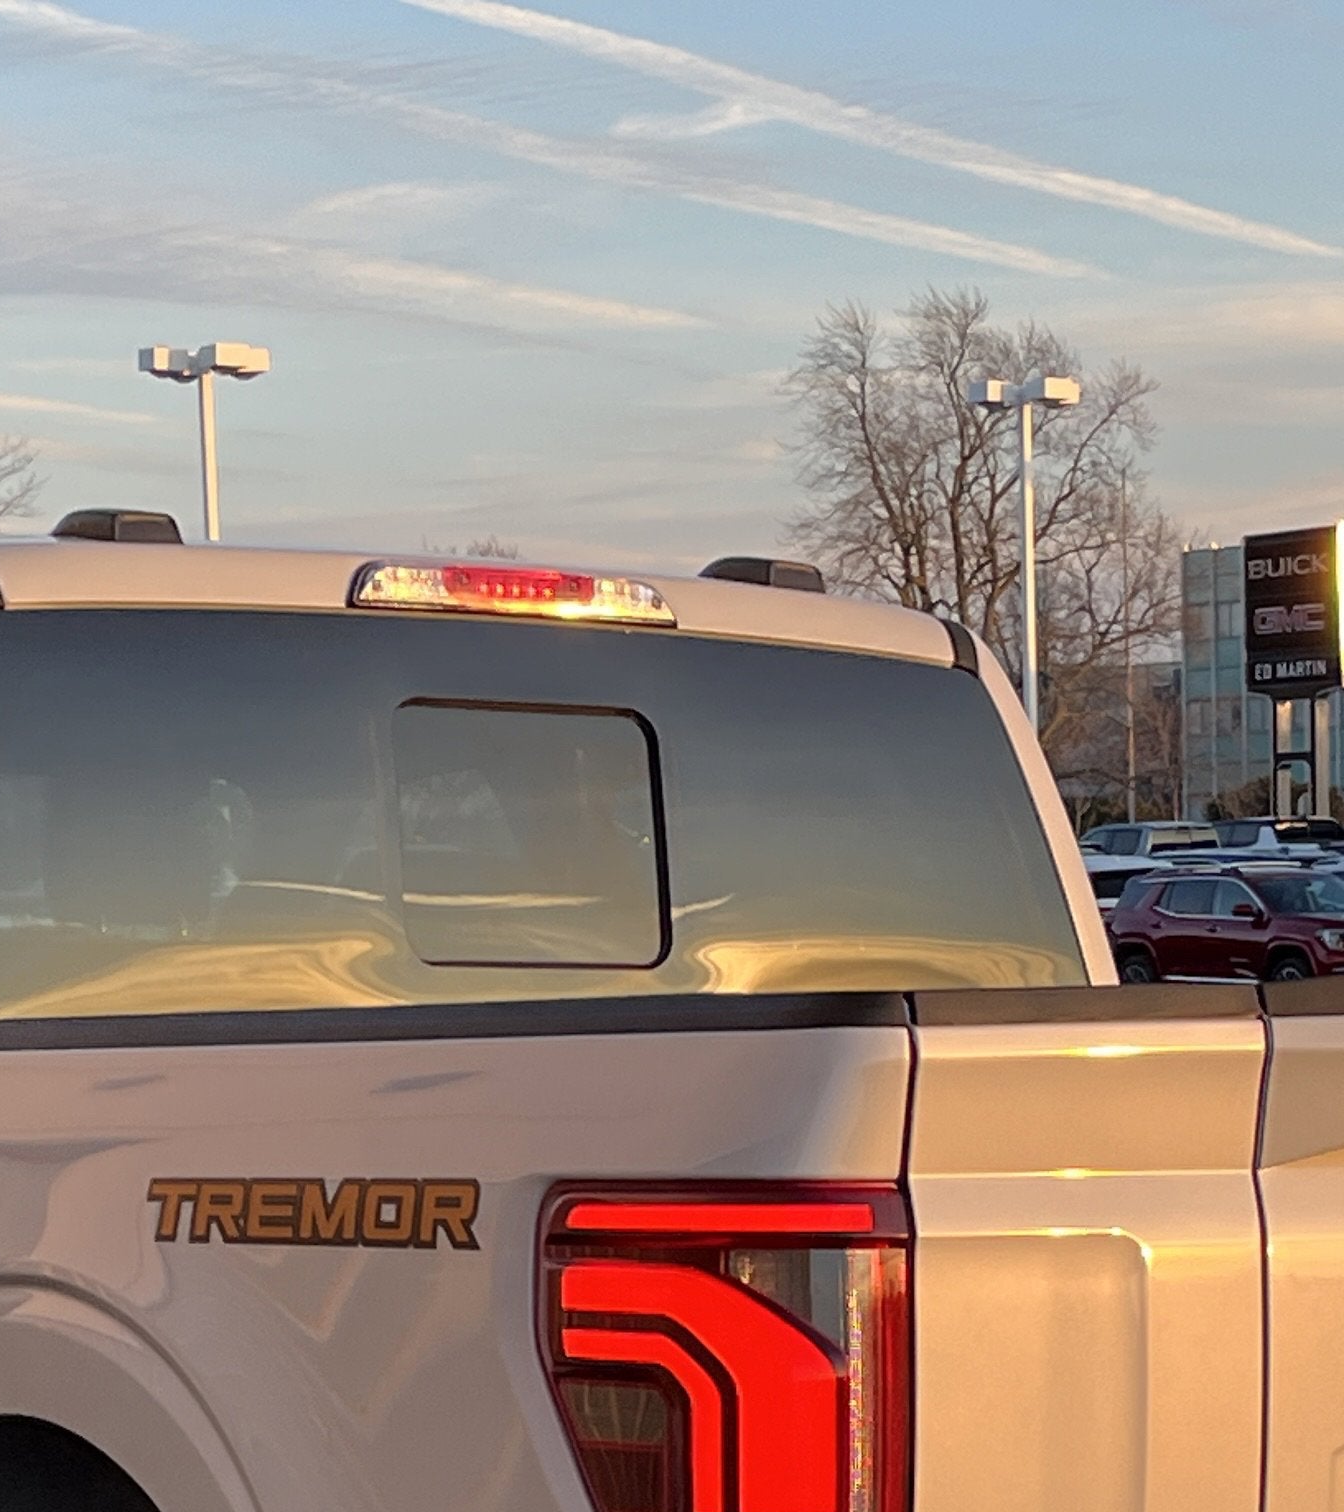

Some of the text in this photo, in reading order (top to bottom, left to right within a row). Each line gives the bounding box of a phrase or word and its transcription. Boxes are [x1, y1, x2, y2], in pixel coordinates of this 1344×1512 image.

[1247, 554, 1329, 580] BUICK
[1253, 603, 1325, 635] GMC
[1254, 659, 1327, 681] ED MARTIN
[146, 1177, 481, 1250] TREMOR
